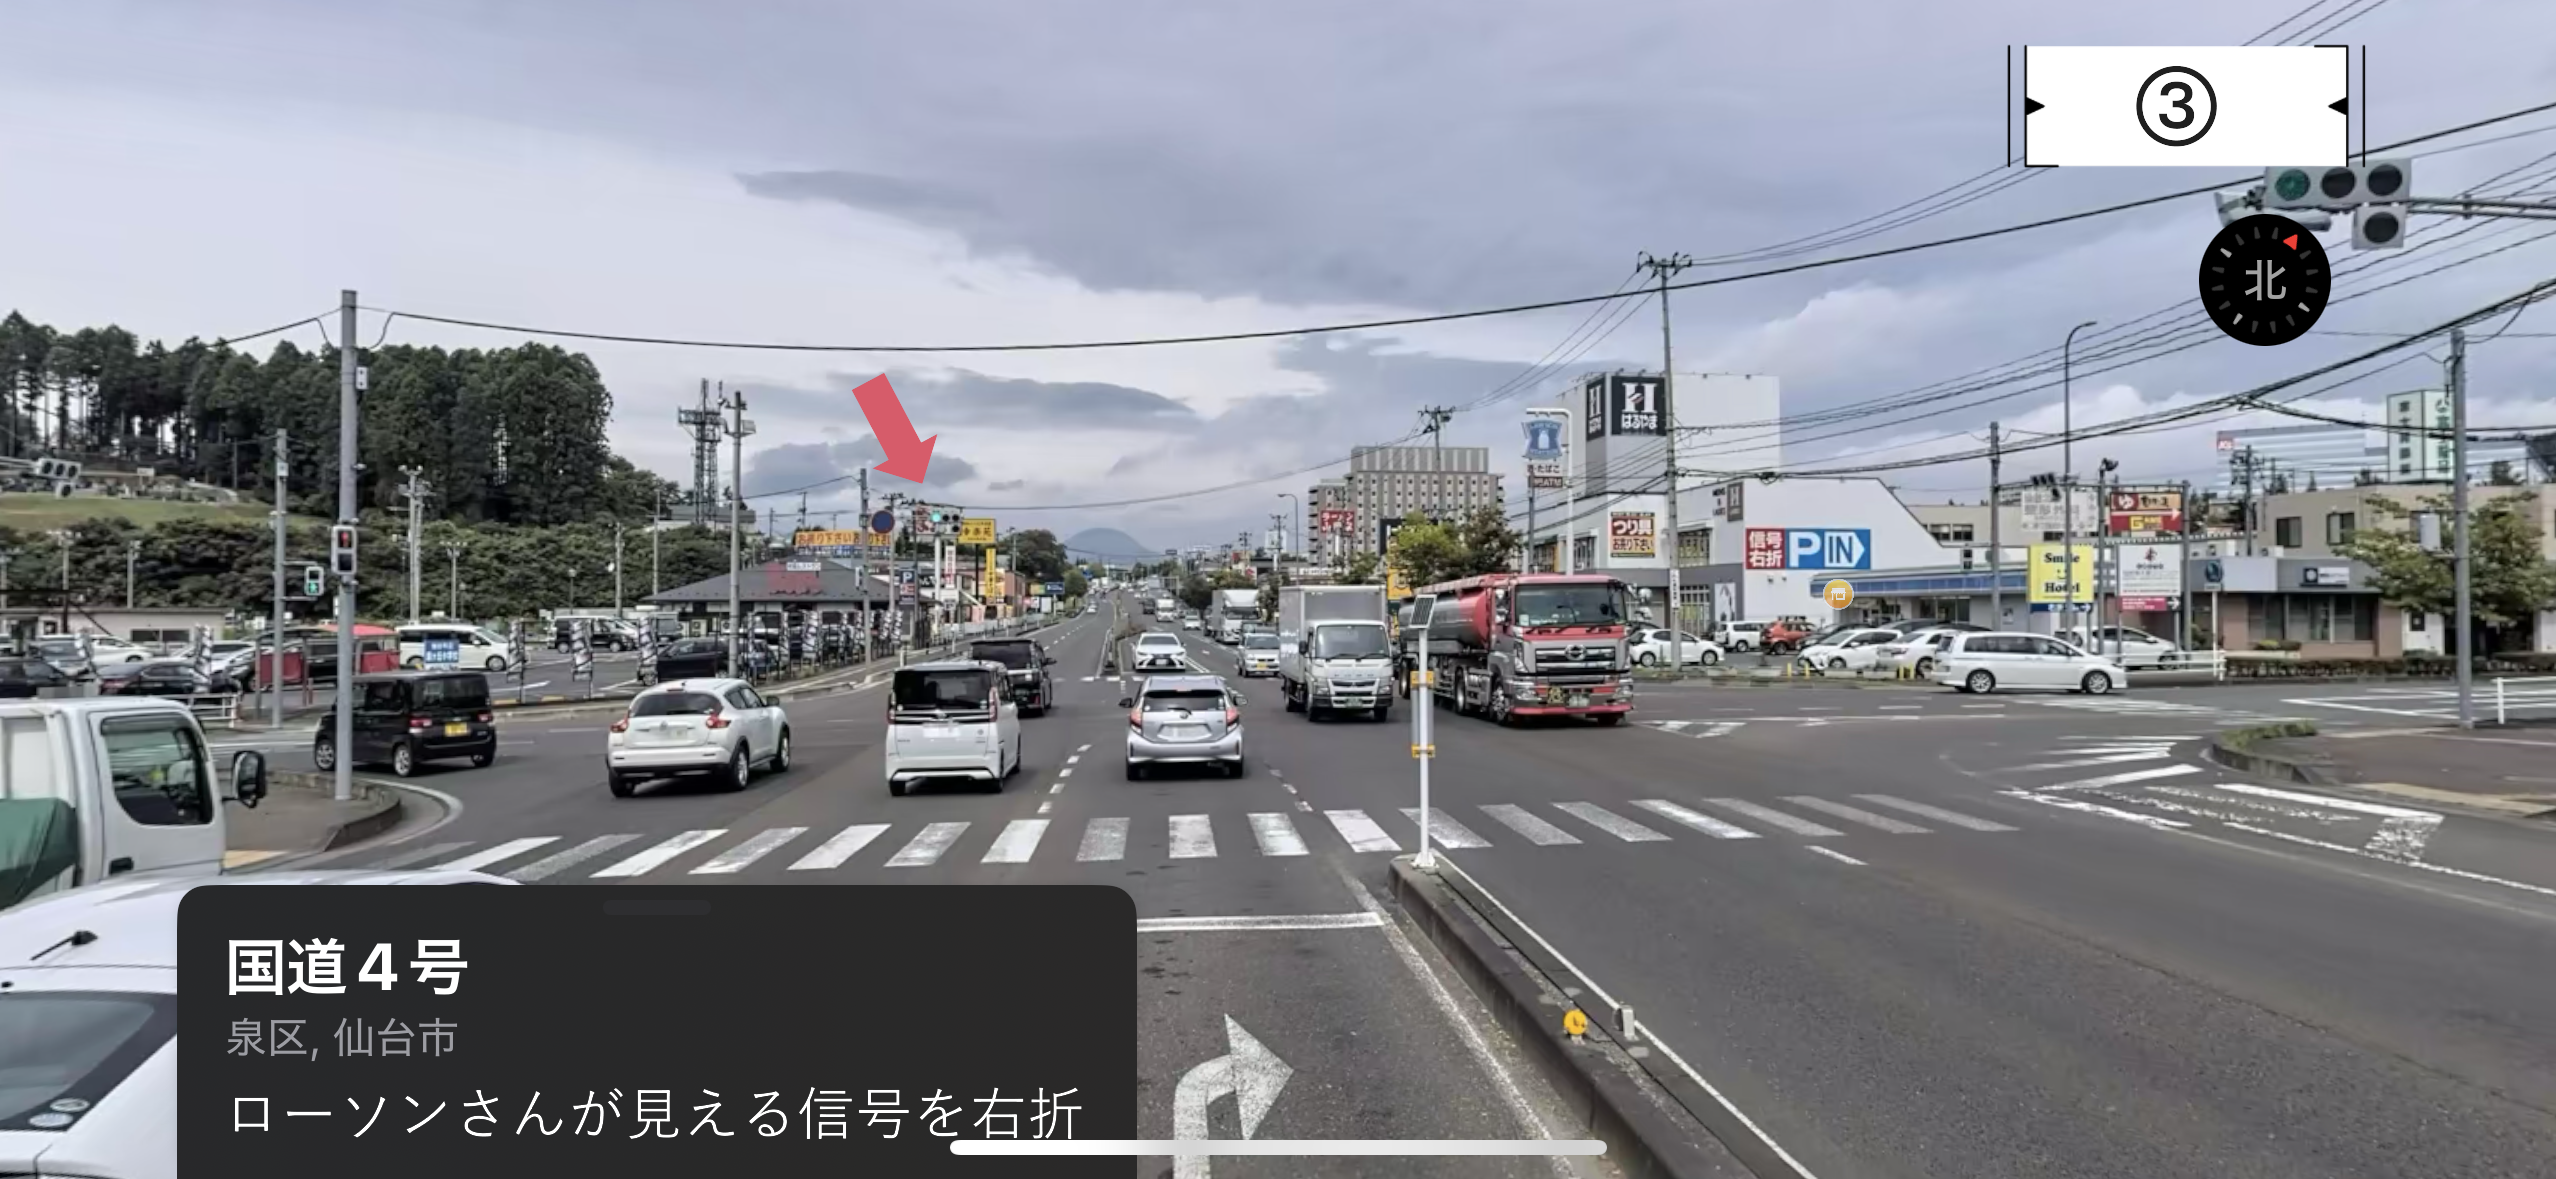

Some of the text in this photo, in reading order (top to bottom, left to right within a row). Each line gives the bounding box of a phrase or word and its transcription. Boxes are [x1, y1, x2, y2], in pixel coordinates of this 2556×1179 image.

[1622, 383, 1658, 413] H
[1621, 413, 1658, 430] はるやま
[1612, 519, 1653, 535] つり具
[1748, 530, 1783, 549] 信号
[1788, 531, 1853, 568] P IN
[2044, 552, 2080, 563] Sme
[1748, 550, 1783, 568] 右折
